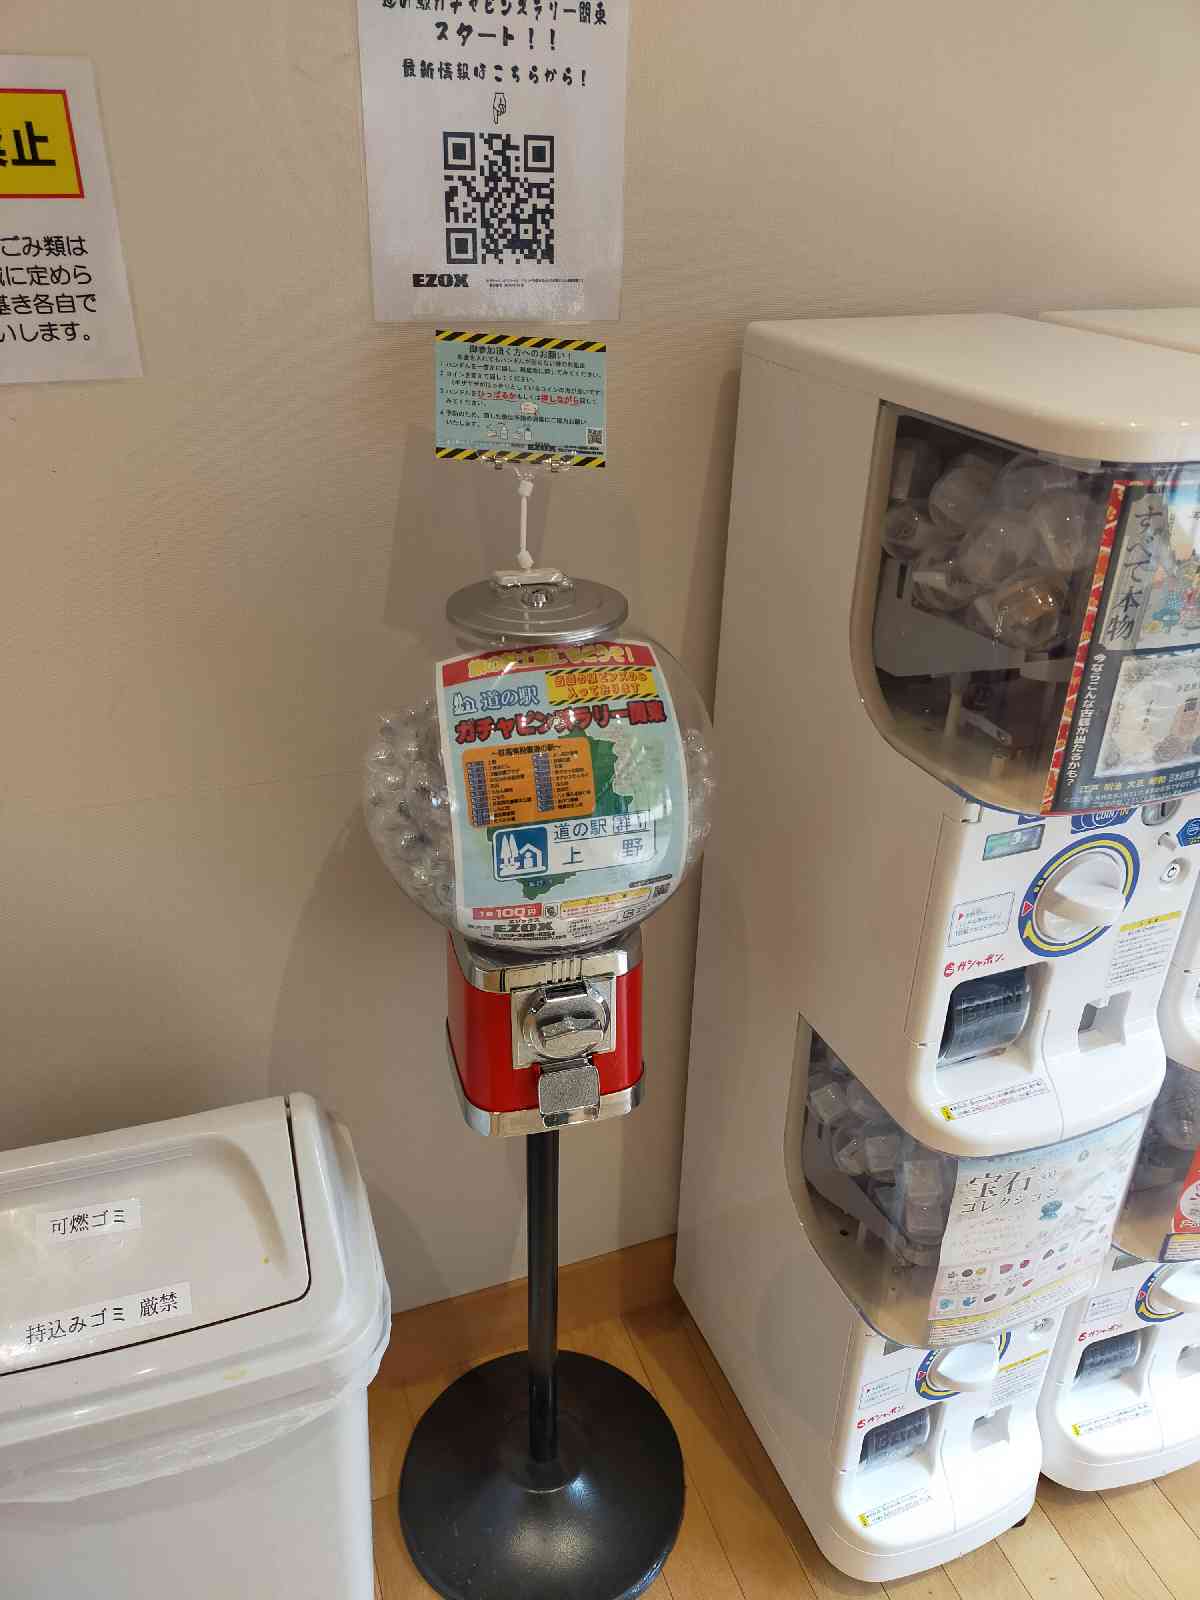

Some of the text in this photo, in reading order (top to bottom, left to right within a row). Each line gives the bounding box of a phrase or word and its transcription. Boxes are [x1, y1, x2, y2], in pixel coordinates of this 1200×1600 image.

[402, 57, 587, 87] 最新情報はこちらから！
[0, 120, 57, 167] 止
[0, 264, 92, 287] に定めら
[412, 273, 469, 288] EZOX
[481, 684, 541, 712] 道の駅
[553, 818, 608, 841] 道の駅
[51, 1209, 126, 1235] 可燃ゴミ
[25, 1291, 179, 1345] 持込みゴミ 厳禁
